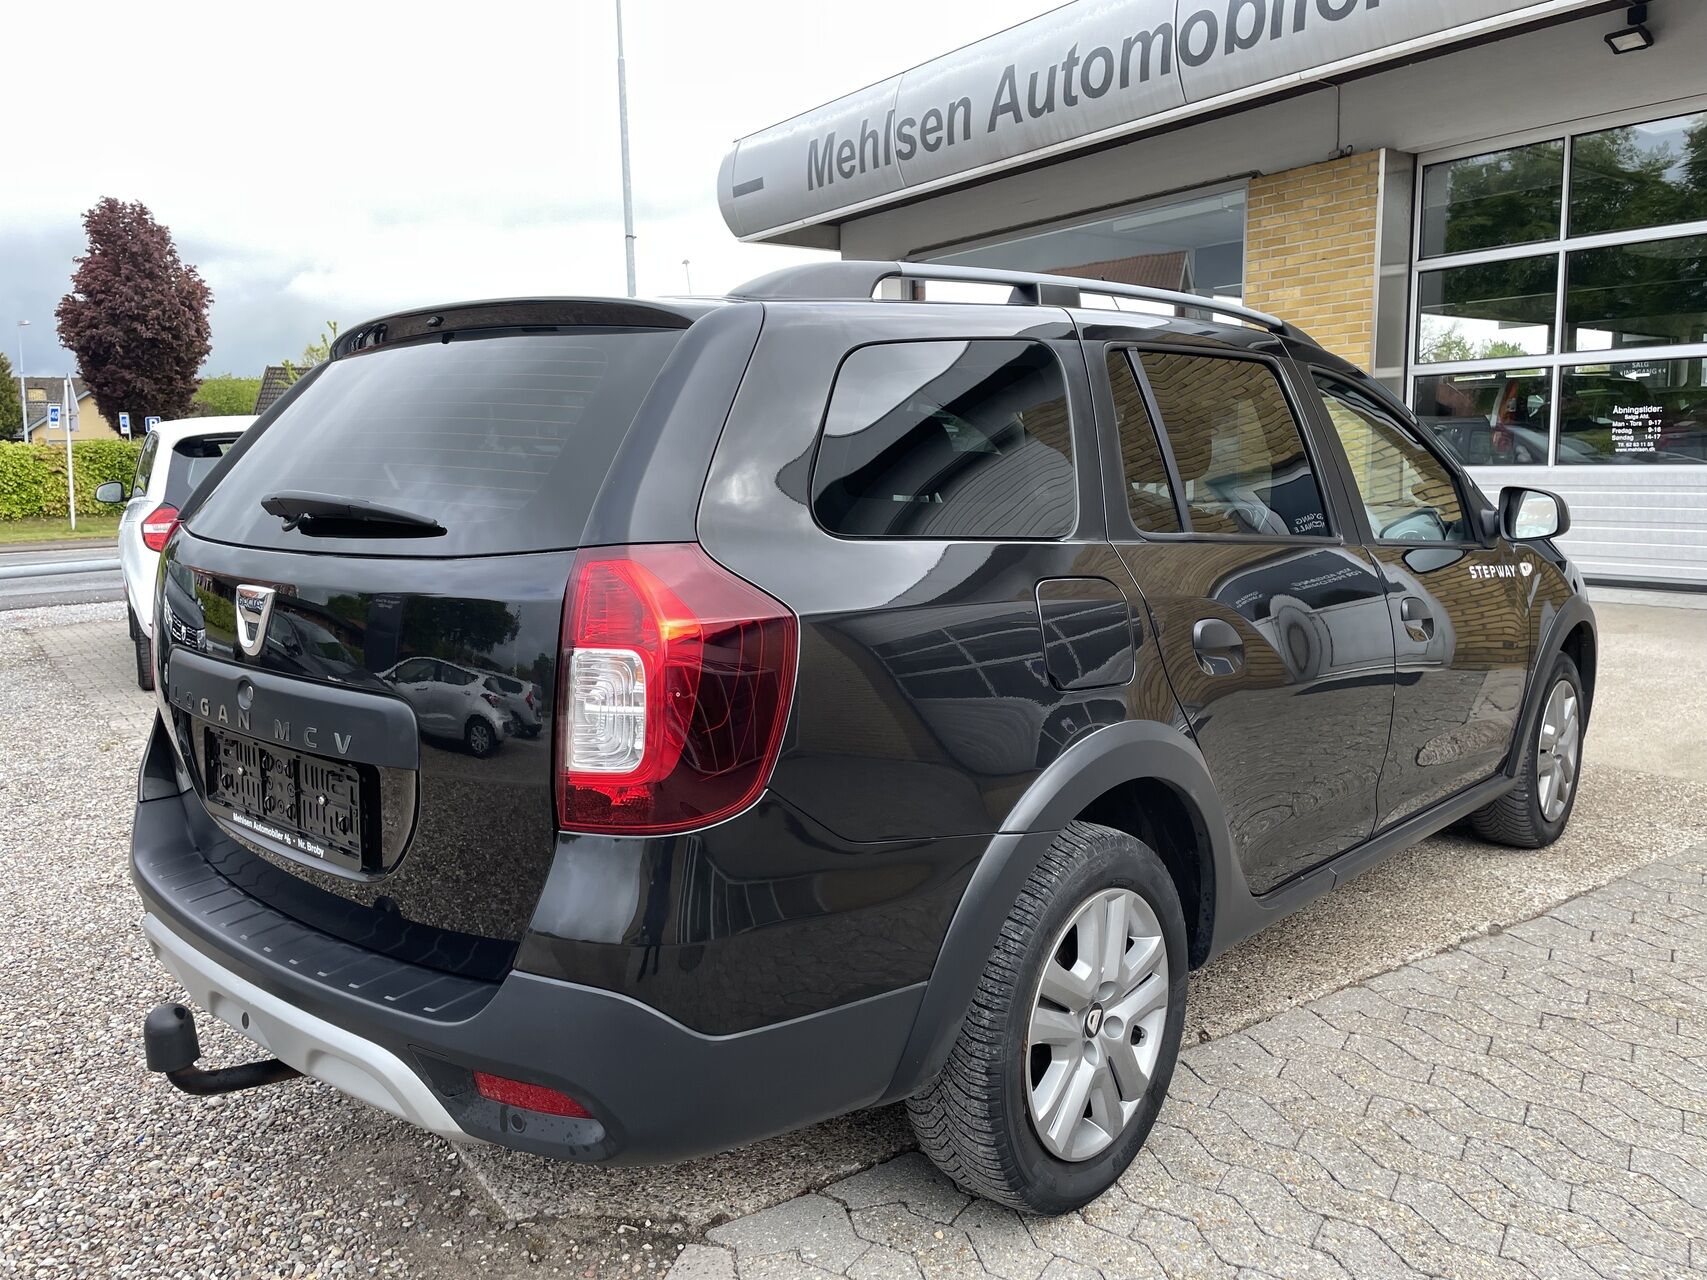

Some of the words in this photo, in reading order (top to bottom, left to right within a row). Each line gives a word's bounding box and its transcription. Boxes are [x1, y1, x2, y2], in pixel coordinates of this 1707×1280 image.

[807, 96, 972, 191] Mehlsen
[1612, 405, 1663, 414] Åbningstider:
[1468, 564, 1516, 579] STEPWAY
[174, 686, 251, 730] LOGAN
[273, 718, 352, 755] MCV
[232, 812, 253, 828] Mehlsen
[253, 821, 283, 840] Automobiler
[298, 839, 306, 850] Nr.
[306, 842, 324, 858] Broby
